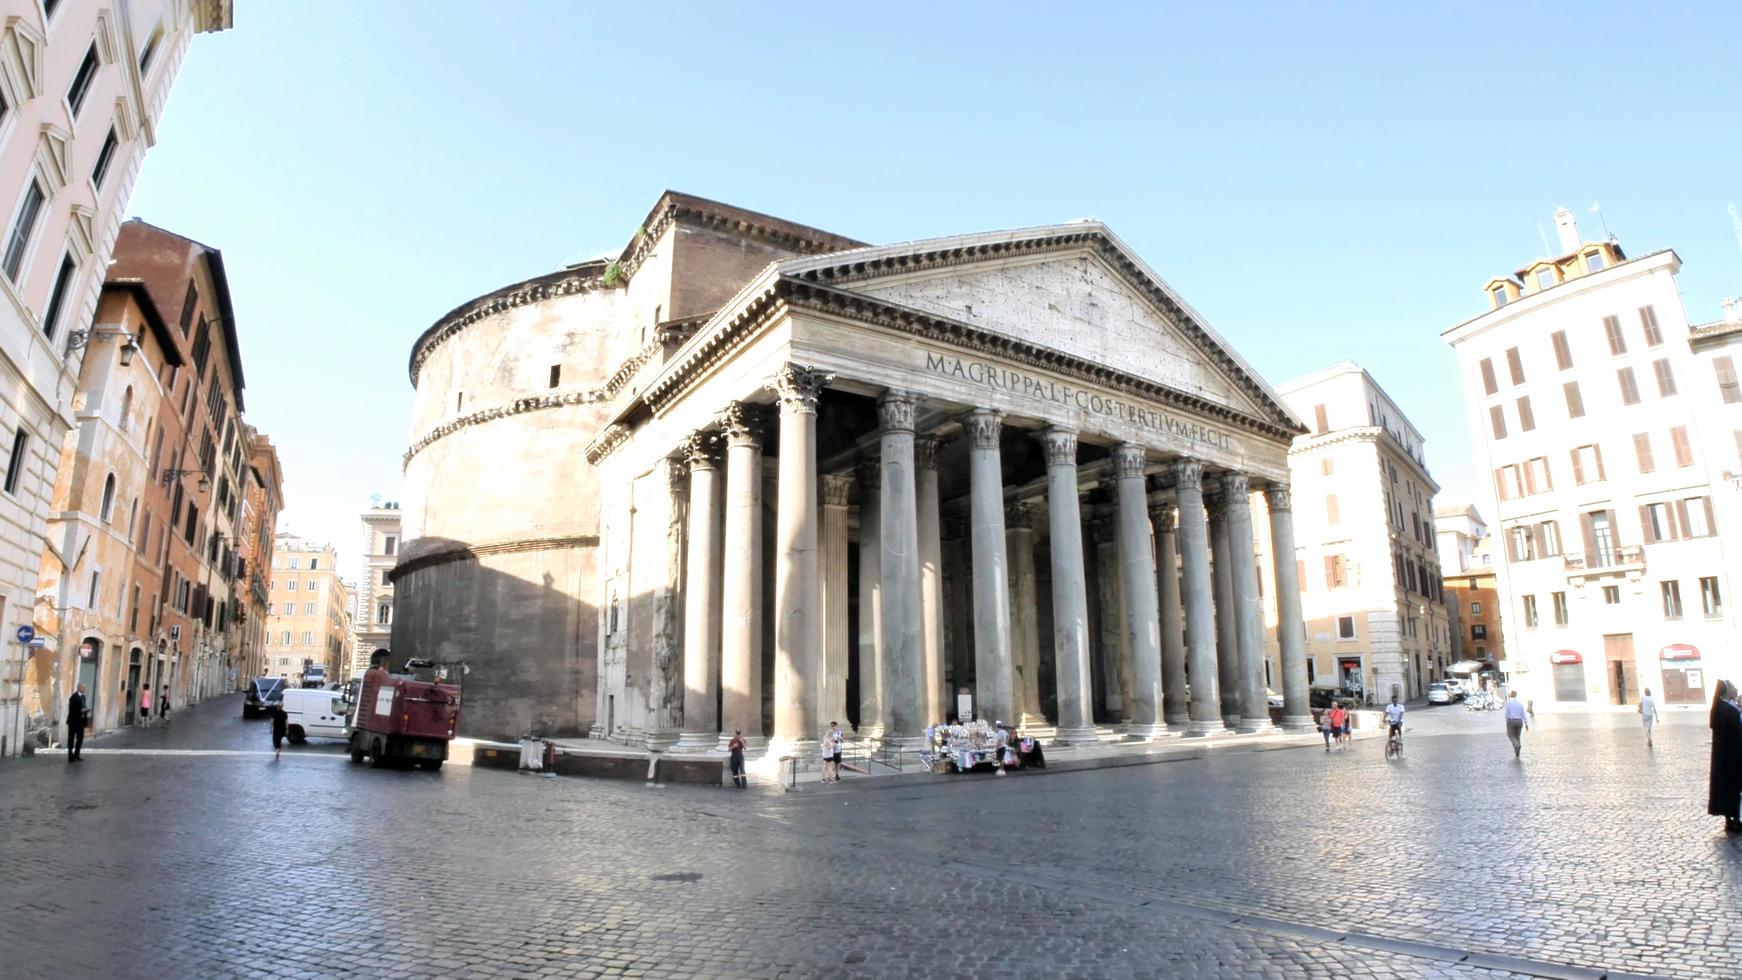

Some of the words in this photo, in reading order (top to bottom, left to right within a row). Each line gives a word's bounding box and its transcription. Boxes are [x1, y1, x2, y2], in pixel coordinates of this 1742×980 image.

[926, 351, 948, 374] M
[951, 358, 1046, 399] AGRIPPA
[1075, 390, 1113, 415] COS
[1115, 402, 1188, 439] TERTIVM
[1191, 424, 1231, 449] FECIT
